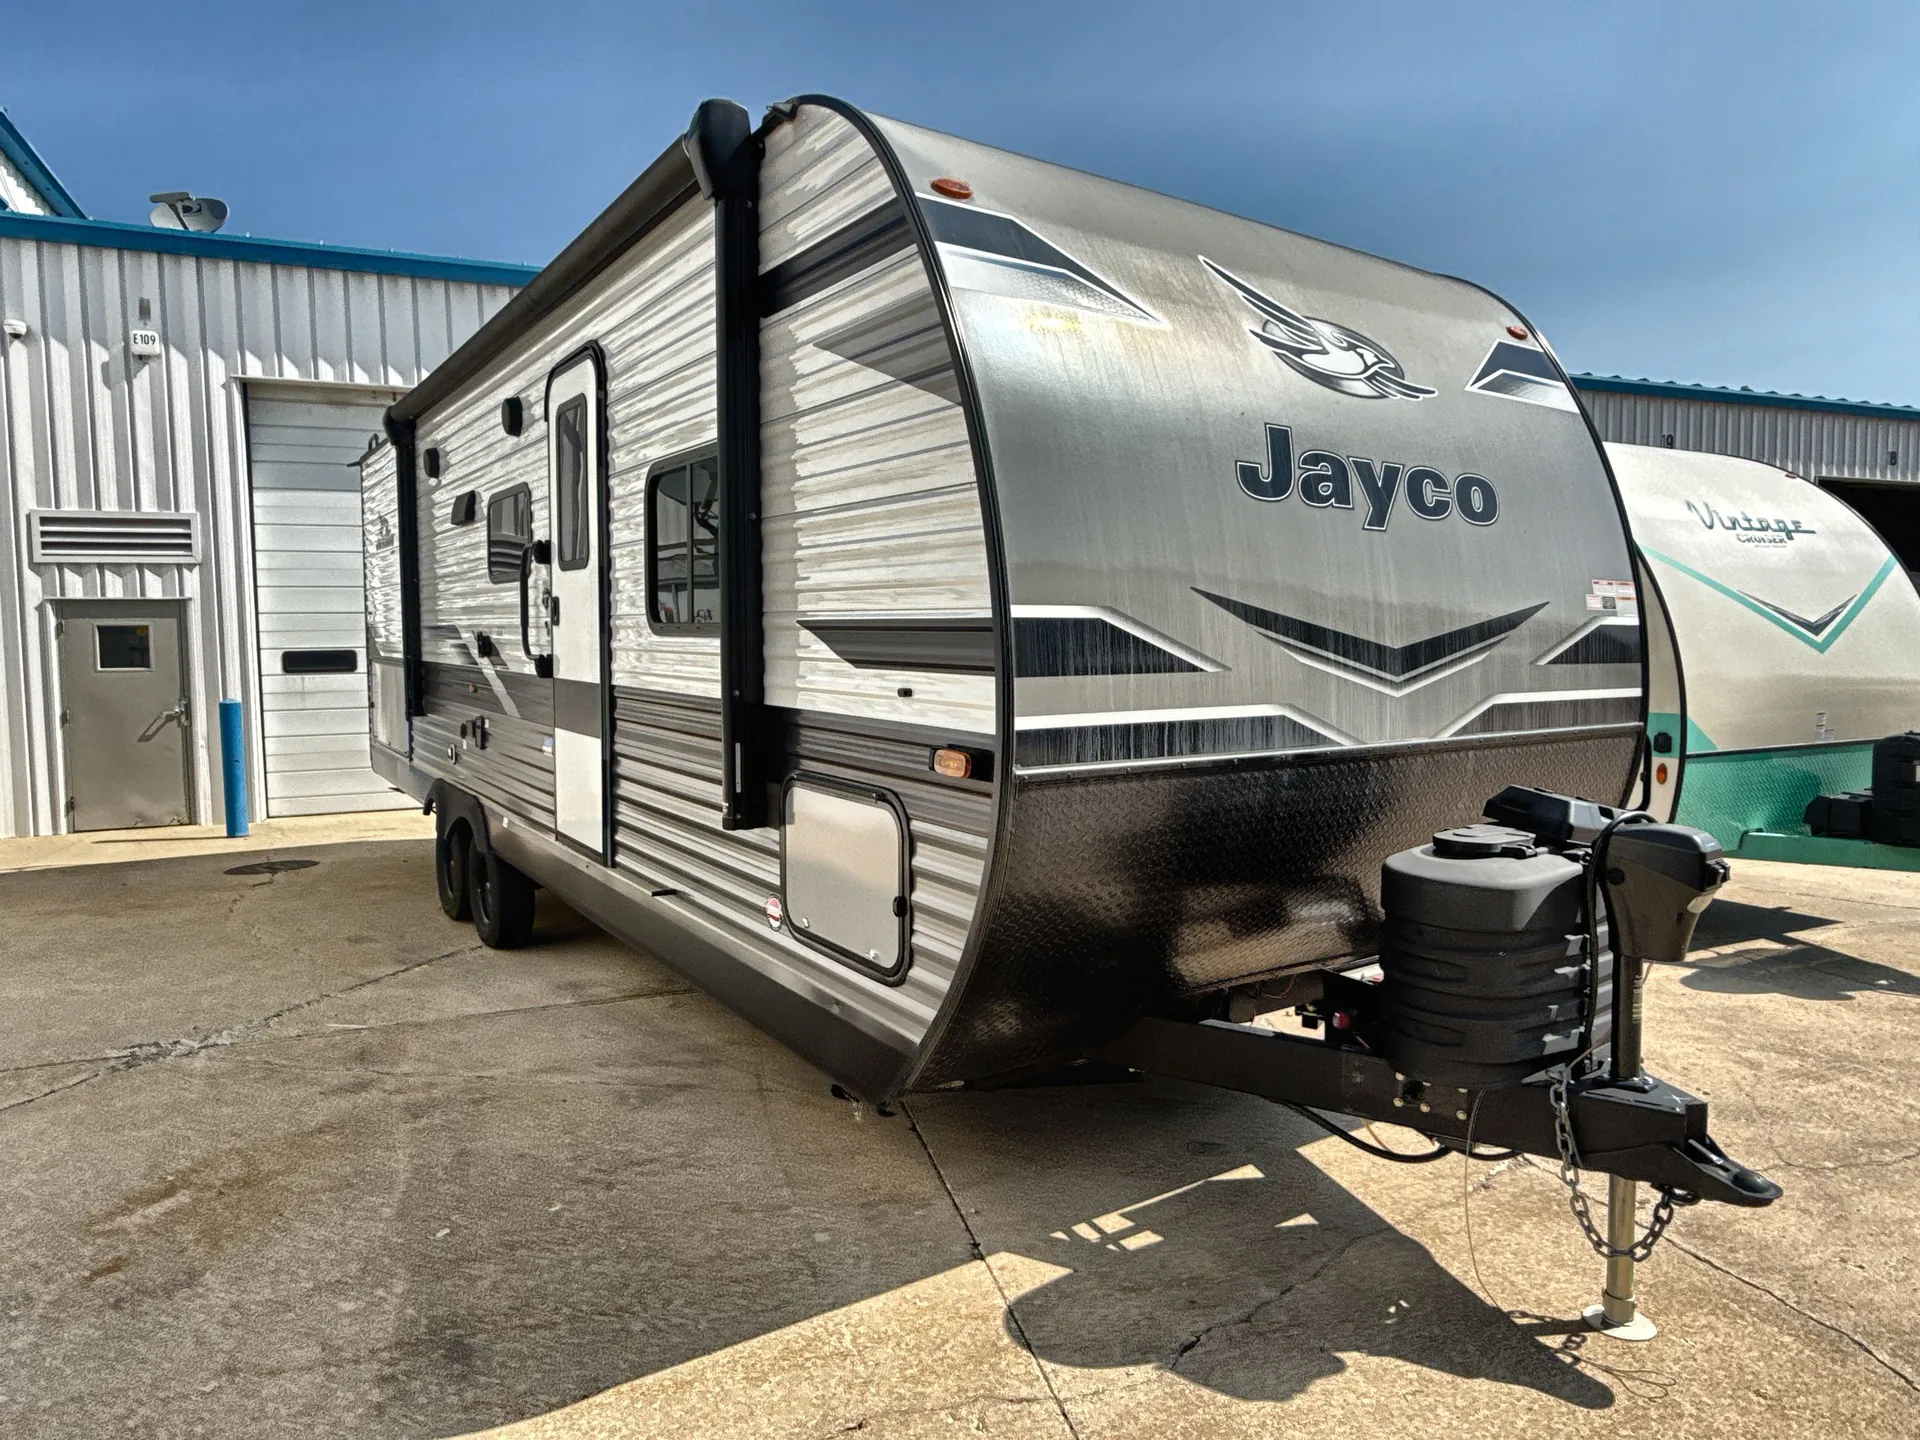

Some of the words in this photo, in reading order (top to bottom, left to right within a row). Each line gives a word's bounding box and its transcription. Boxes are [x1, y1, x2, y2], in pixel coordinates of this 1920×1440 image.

[133, 333, 156, 345] E109
[1234, 422, 1500, 532] Jayco
[1684, 499, 1817, 541] Vintage
